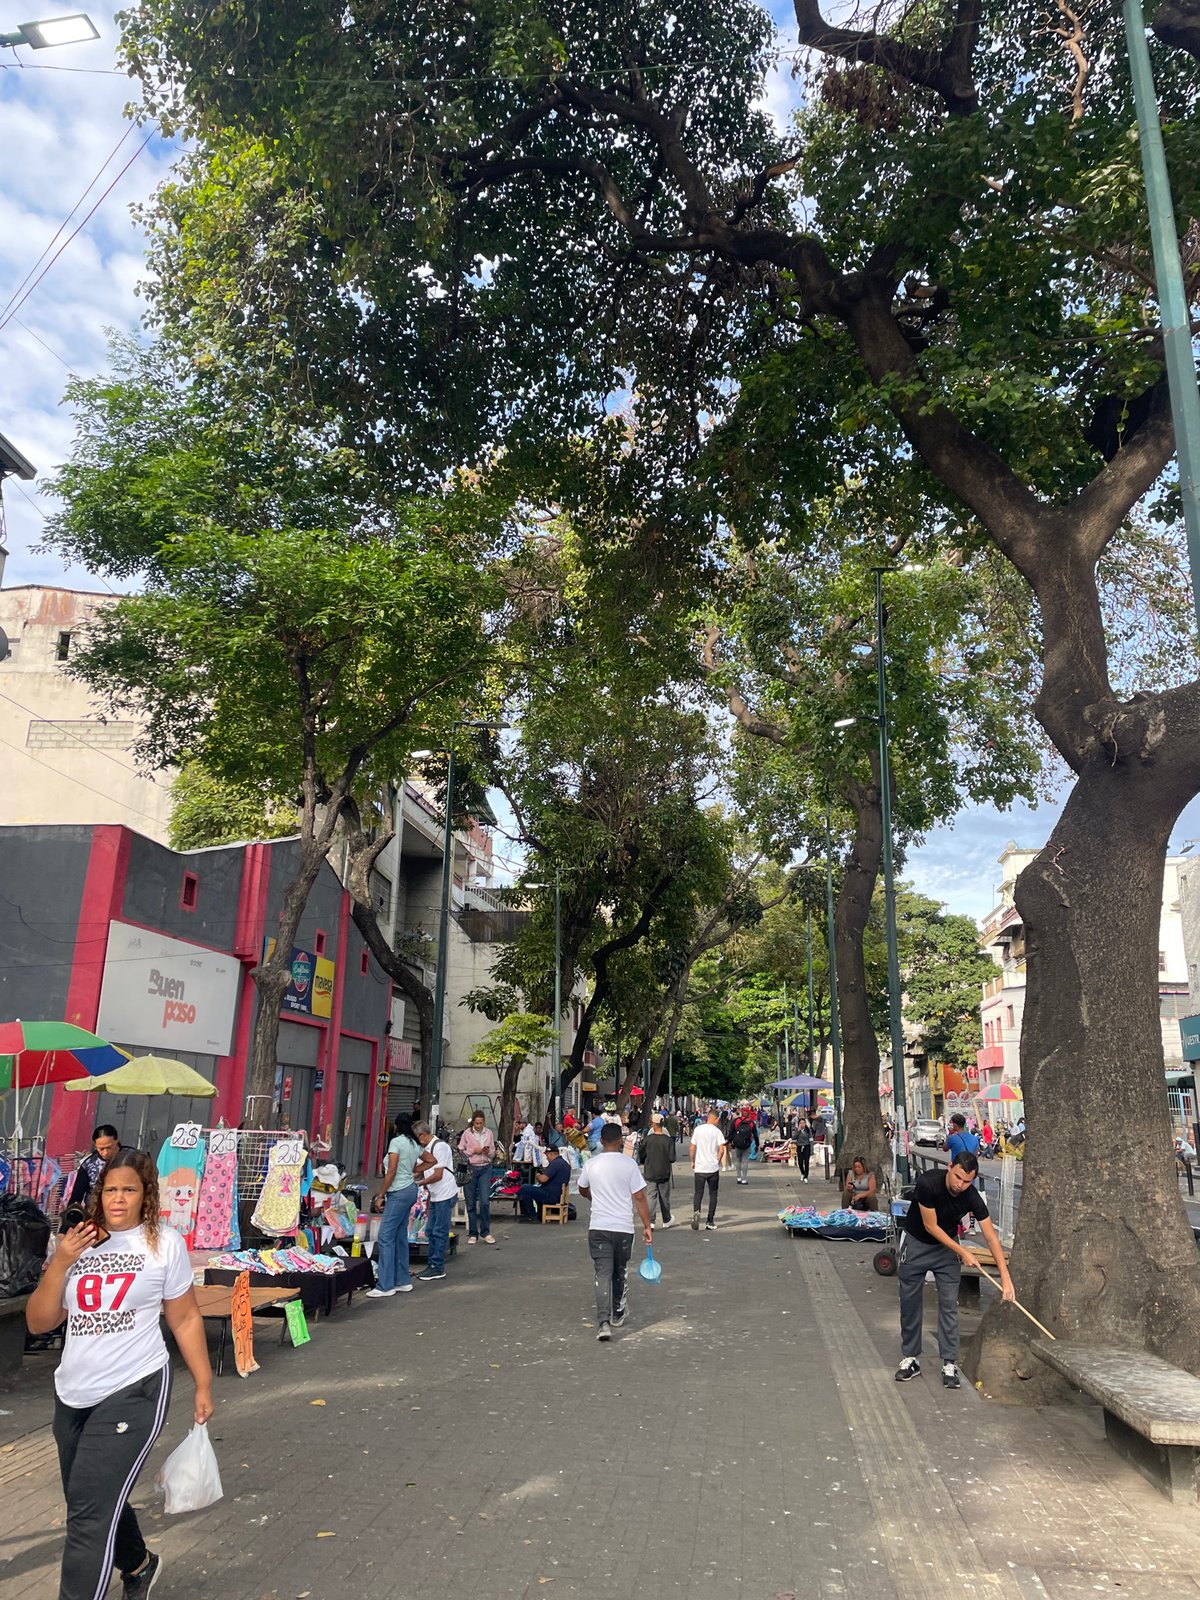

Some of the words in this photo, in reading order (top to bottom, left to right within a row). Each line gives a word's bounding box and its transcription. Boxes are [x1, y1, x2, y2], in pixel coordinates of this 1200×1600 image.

[147, 968, 185, 1001] Buen
[315, 975, 333, 993] mavesa
[162, 1000, 196, 1028] paso
[377, 1074, 390, 1083] PAN
[76, 1272, 136, 1313] 87
